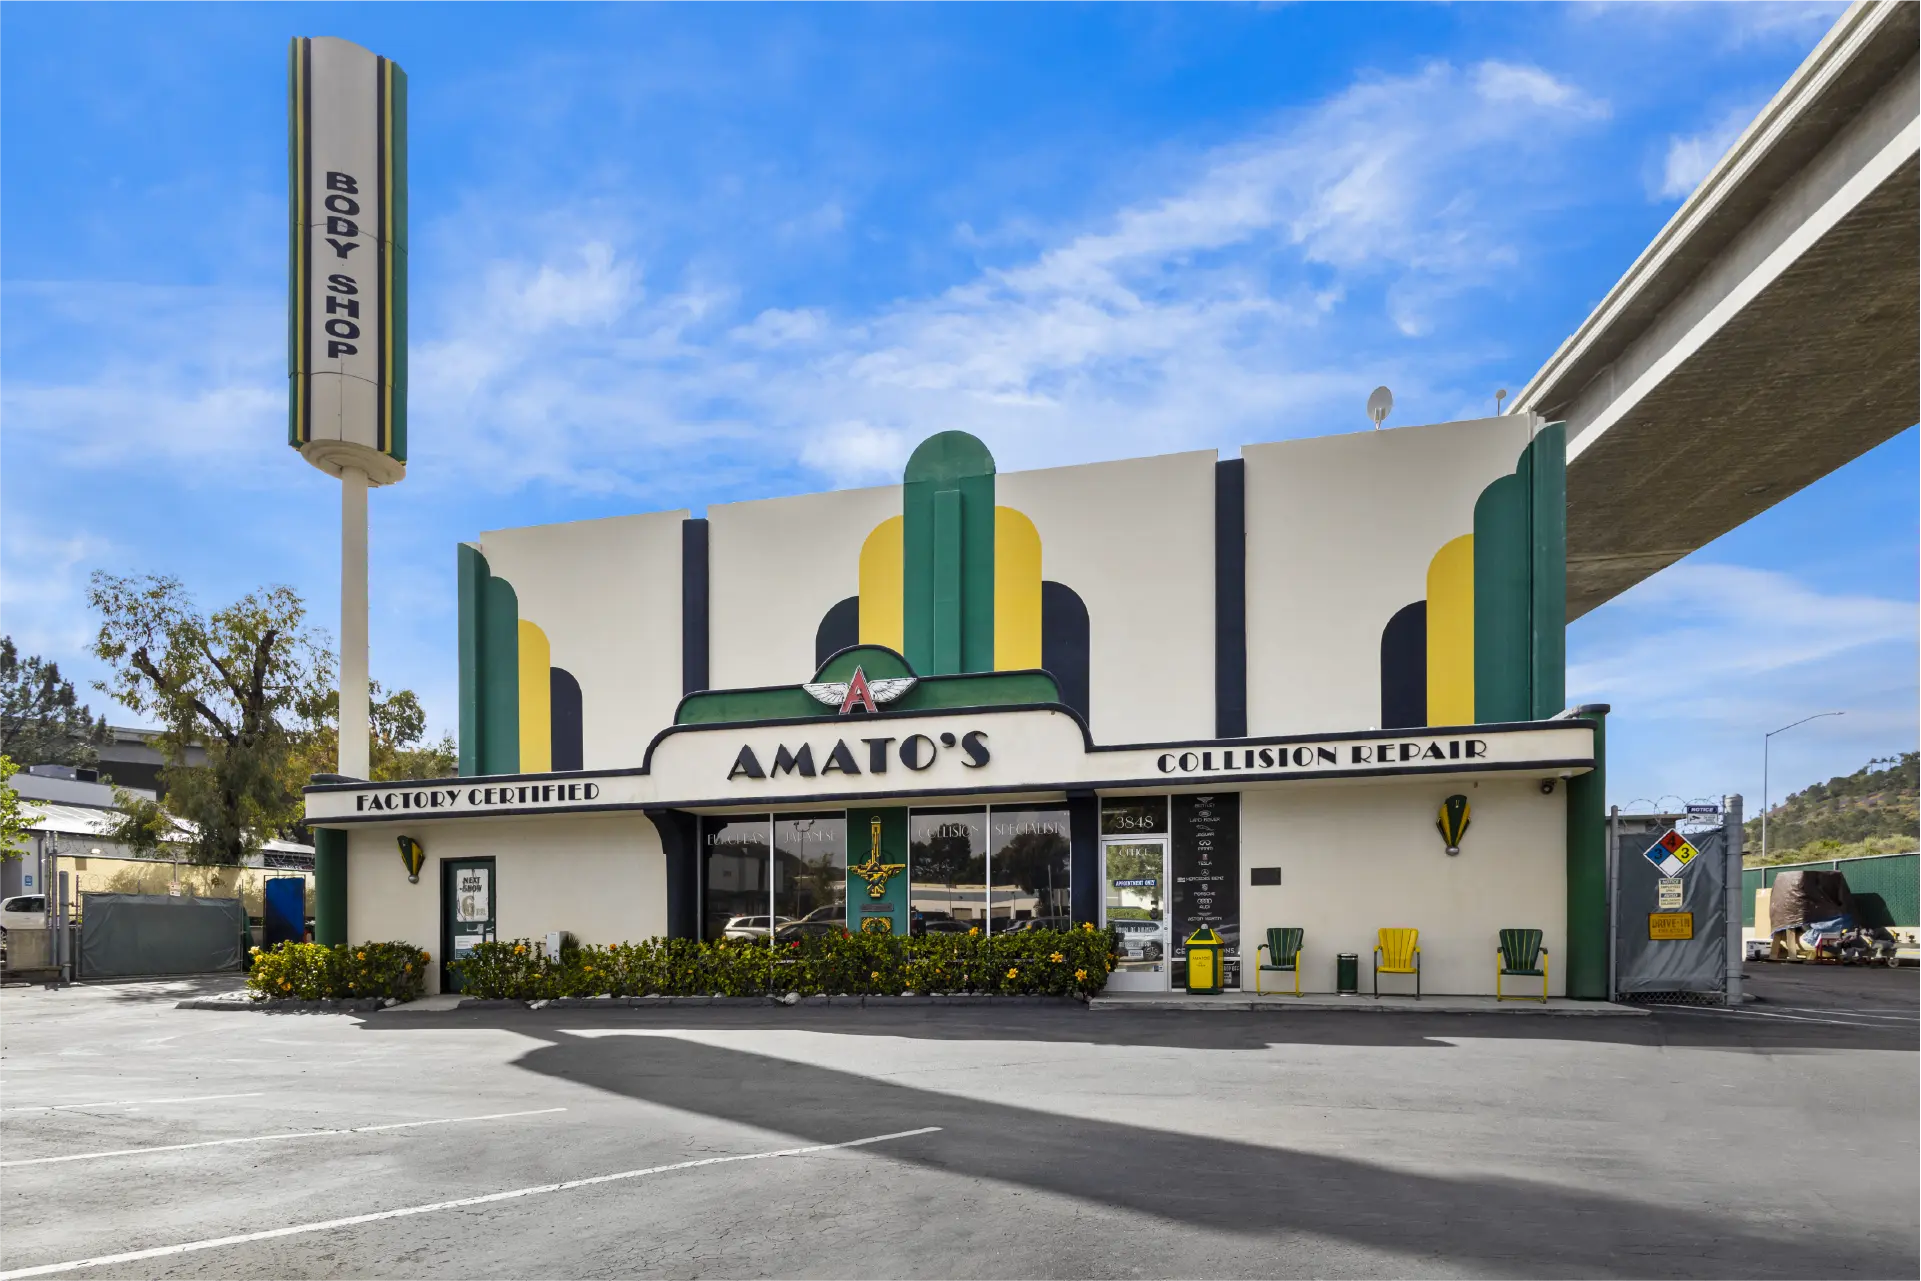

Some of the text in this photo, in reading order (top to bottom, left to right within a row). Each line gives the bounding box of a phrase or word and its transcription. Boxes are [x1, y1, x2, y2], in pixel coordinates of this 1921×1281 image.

[325, 171, 361, 359] BODY SHOP
[839, 664, 879, 714] A
[726, 730, 992, 781] AMATO'S
[1157, 739, 1488, 774] COLLISION REPAIR
[356, 782, 600, 812] FACTORY CERTIFIED
[995, 822, 1066, 836] SPECIALISTS
[1115, 815, 1154, 829] 3848
[707, 831, 765, 846] EUROPEAN
[918, 825, 979, 839] COLLISION
[1667, 835, 1676, 848] 4
[1654, 848, 1663, 860] 3
[1681, 847, 1690, 859] 3
[463, 876, 481, 885] NEXT
[1651, 918, 1691, 929] DRIVE-IN
